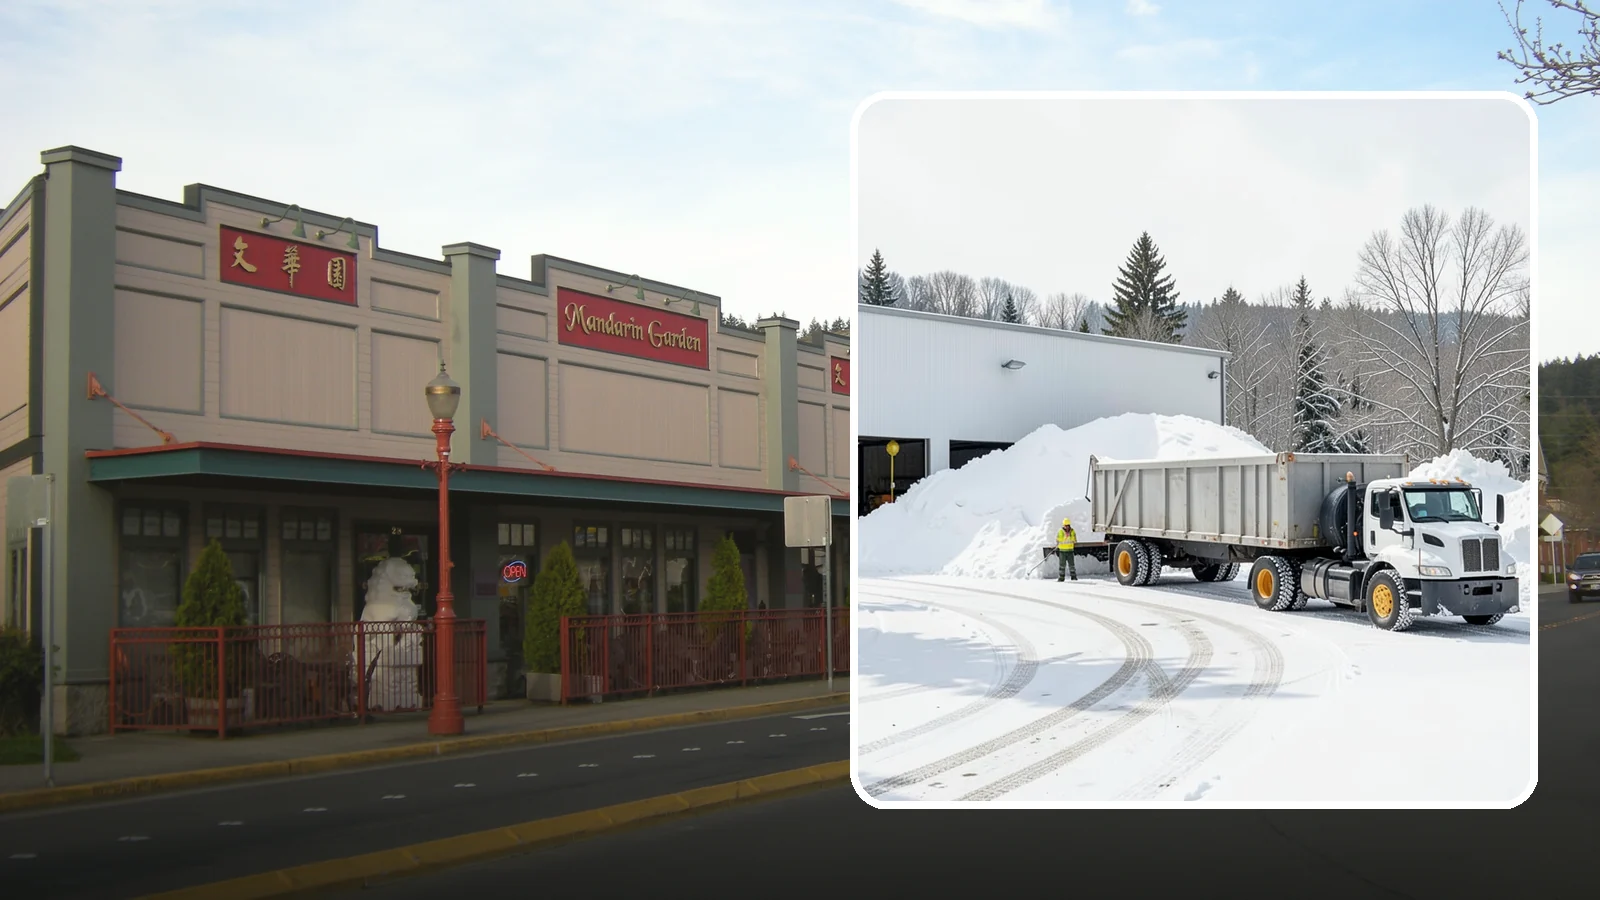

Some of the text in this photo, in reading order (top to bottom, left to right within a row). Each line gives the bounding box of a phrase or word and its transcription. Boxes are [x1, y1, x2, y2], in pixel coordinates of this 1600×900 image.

[564, 302, 701, 352] Mandarin Garden
[503, 565, 527, 578] OPEN
